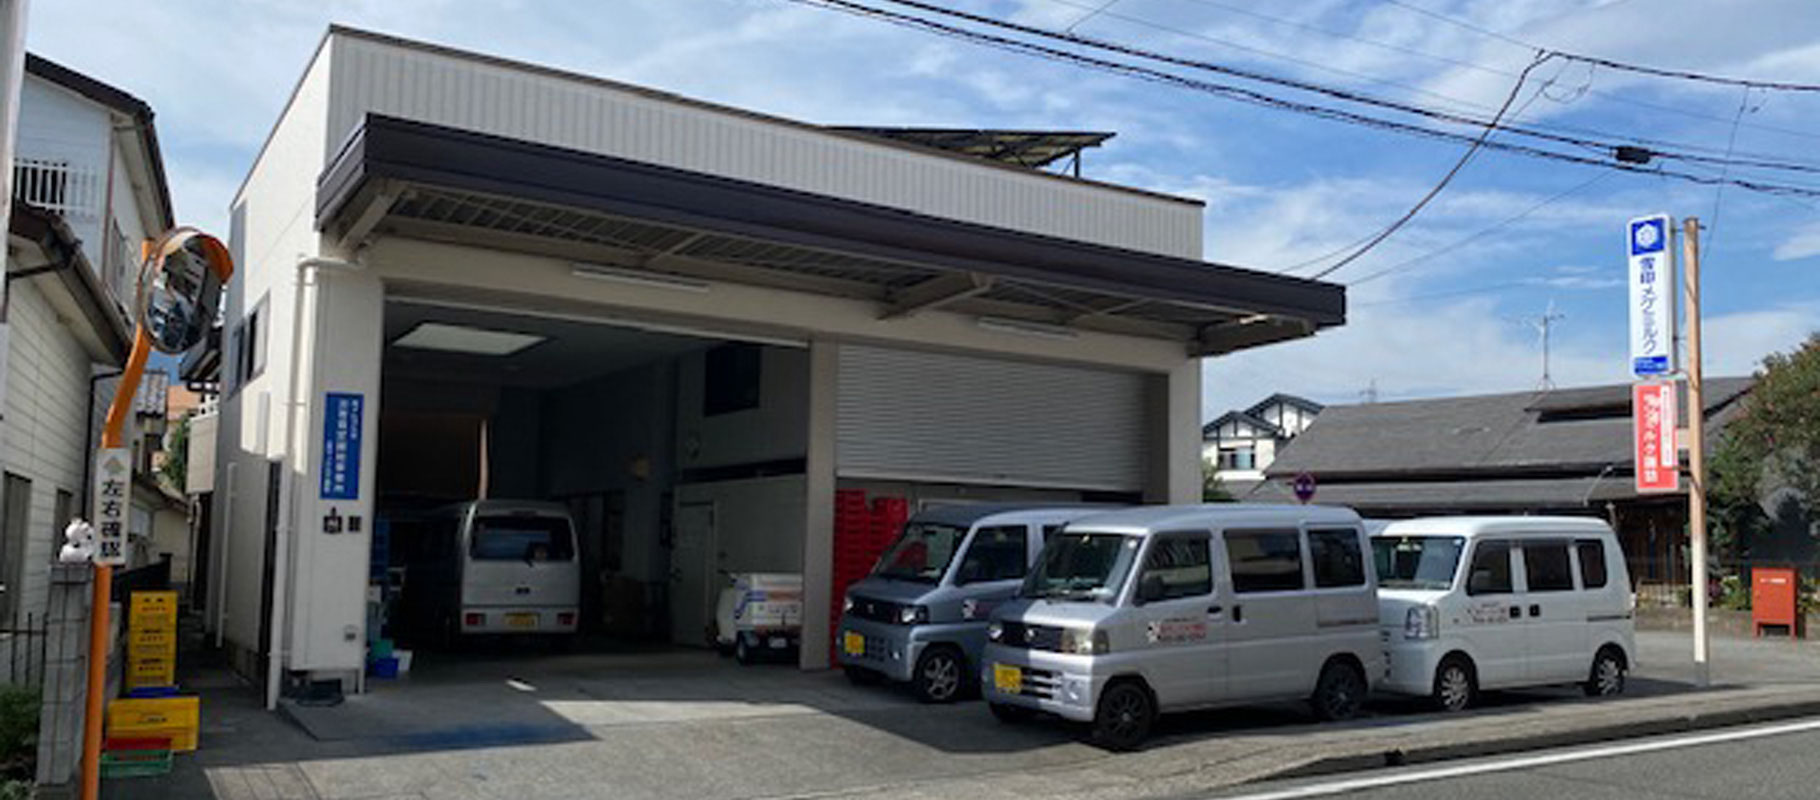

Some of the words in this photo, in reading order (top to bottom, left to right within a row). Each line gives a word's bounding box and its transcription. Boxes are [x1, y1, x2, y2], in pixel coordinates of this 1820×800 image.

[1639, 256, 1658, 355] 雪印メグミルク
[101, 479, 125, 558] 左右確認
